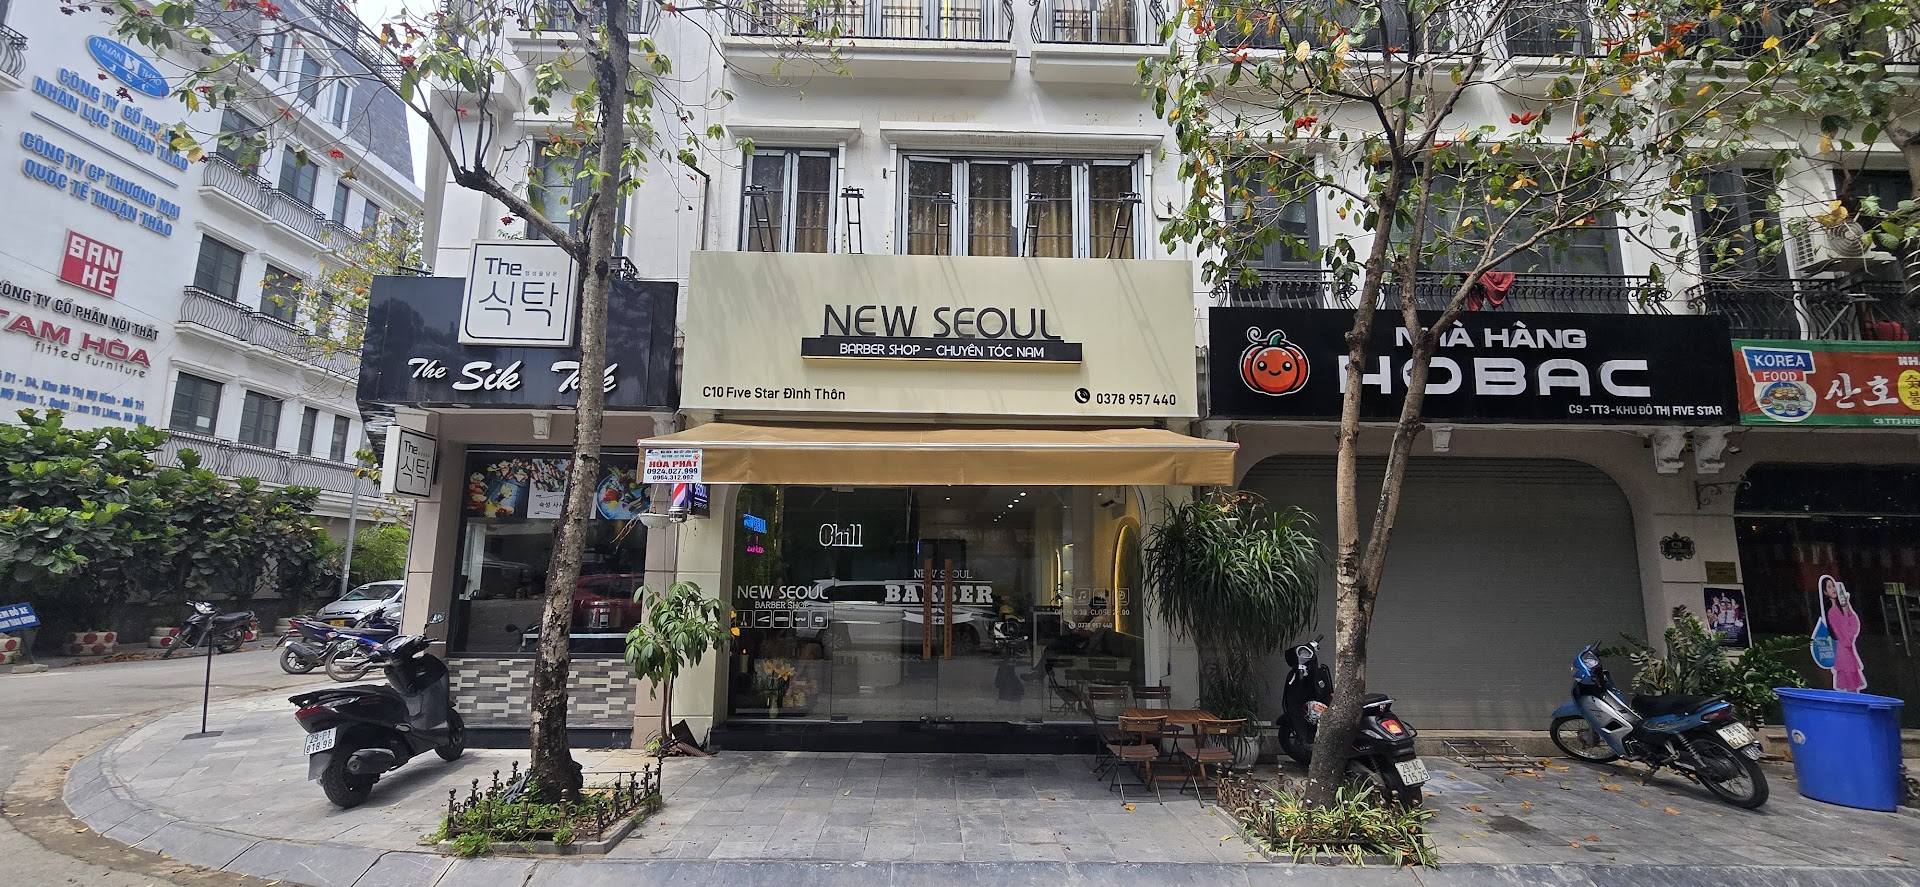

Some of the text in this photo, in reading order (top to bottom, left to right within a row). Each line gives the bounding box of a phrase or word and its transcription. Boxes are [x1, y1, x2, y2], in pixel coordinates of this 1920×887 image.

[59, 68, 100, 101] CÔNG
[102, 92, 119, 112] TY
[123, 105, 143, 125] CỔ
[34, 76, 79, 112] NHÂN
[82, 101, 110, 127] LỰC
[113, 119, 155, 154] THUẬN
[23, 132, 180, 220] CÔNG TY CP THƯƠNG MẠI
[25, 159, 172, 237] QUỐC TẾ THUẬN THẢO
[69, 235, 119, 271] SAN
[485, 257, 522, 276] The
[0, 279, 159, 340] ÔNG TY CỔ PHẦN NỘI THẤT
[479, 281, 559, 327] 식탁
[823, 304, 1061, 340] NEW SEOUL
[1395, 319, 1587, 348] NÀ HÀNG
[35, 341, 146, 378] fitted furniture
[82, 332, 150, 367] HÒA
[839, 343, 885, 356] BARBER
[888, 344, 921, 356] SHOP
[935, 342, 984, 357] CHUYÊN
[987, 342, 1013, 358] TÓC
[1016, 345, 1044, 358] NAM
[1754, 354, 1806, 367] KOREA
[1898, 356, 1920, 366] NH
[408, 357, 446, 379] The
[452, 360, 522, 391] Sik
[1337, 354, 1651, 397] HOBAC
[1762, 371, 1798, 382] FOOD
[42, 380, 58, 392] Khu
[702, 386, 846, 400] C10 Five Star Đình Thôn
[1824, 373, 1899, 409] 산호
[1096, 393, 1176, 406] 0378 957 440
[1638, 403, 1652, 415] ĐÔ
[1653, 405, 1671, 416] THỊ
[1672, 406, 1694, 415] FIVE
[1696, 405, 1723, 415] STAR
[404, 440, 418, 455] The
[400, 456, 430, 488] 식탁
[819, 523, 863, 547] Chill
[940, 569, 973, 578] SOUL
[737, 585, 828, 599] NEW SEOUL
[885, 584, 993, 603] BARBER
[755, 601, 786, 609] BARBER
[306, 738, 332, 753] 818.98
[1403, 770, 1429, 784] 215.25
